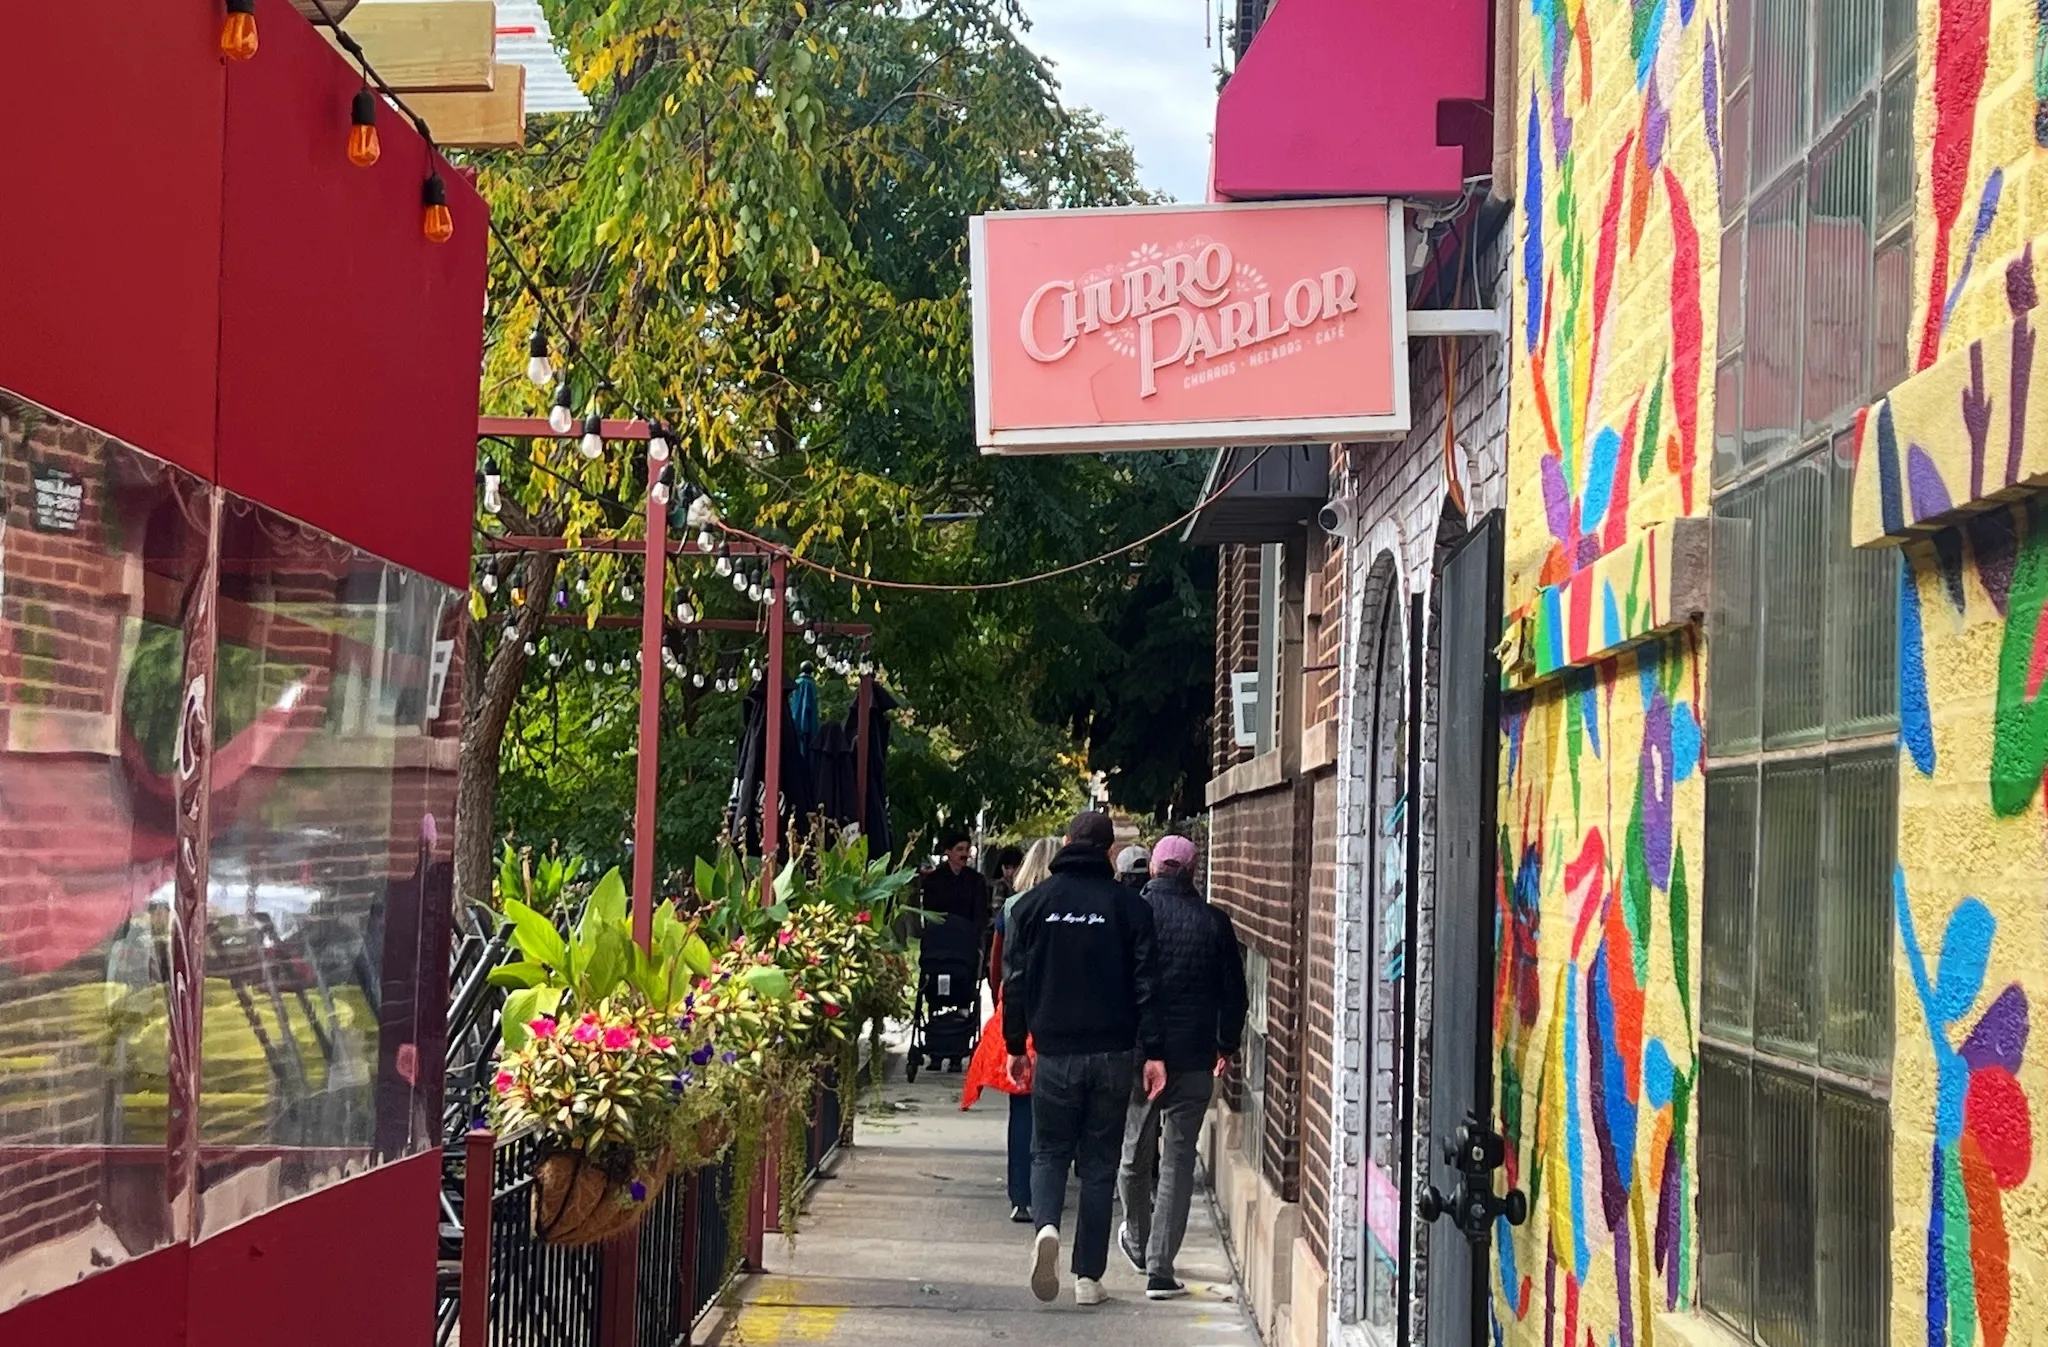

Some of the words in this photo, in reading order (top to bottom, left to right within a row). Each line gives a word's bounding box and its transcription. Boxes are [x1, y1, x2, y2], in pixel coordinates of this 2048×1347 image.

[1020, 243, 1232, 362] CHURRO
[1138, 266, 1358, 398] PARLOR
[1184, 362, 1236, 388] CHURROS
